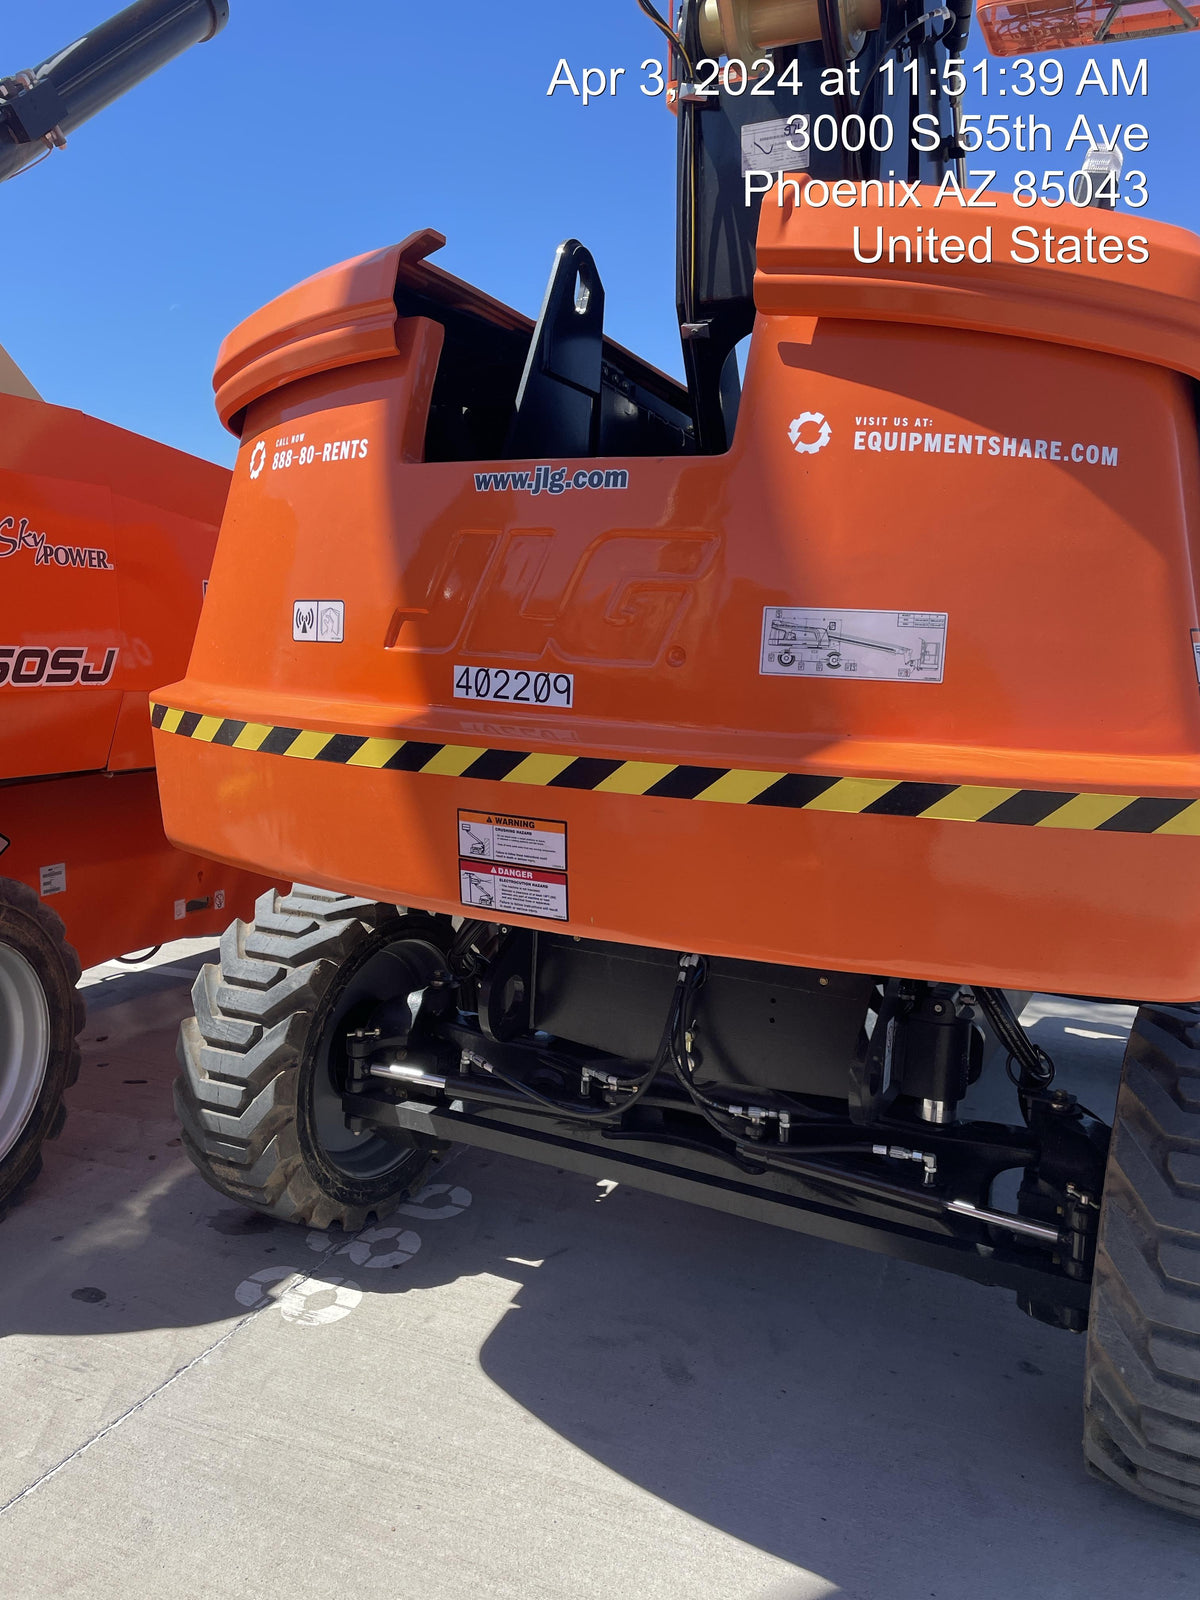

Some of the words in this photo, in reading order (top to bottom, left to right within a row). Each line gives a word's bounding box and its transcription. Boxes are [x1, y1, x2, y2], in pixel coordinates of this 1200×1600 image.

[854, 416, 888, 427] VISIT
[893, 416, 910, 427] US
[914, 417, 934, 428] AT:
[275, 437, 289, 448] CALL
[291, 433, 306, 443] NOW
[271, 438, 369, 471] 888-80-RENTS
[853, 430, 1119, 467] EQUIPMENTSHARE.COM
[474, 466, 629, 496] www.jlg.com
[454, 666, 572, 706] 402209
[495, 816, 535, 829] WARNING
[497, 867, 534, 879] DANGER
[499, 878, 532, 887] ELECTROCUTION
